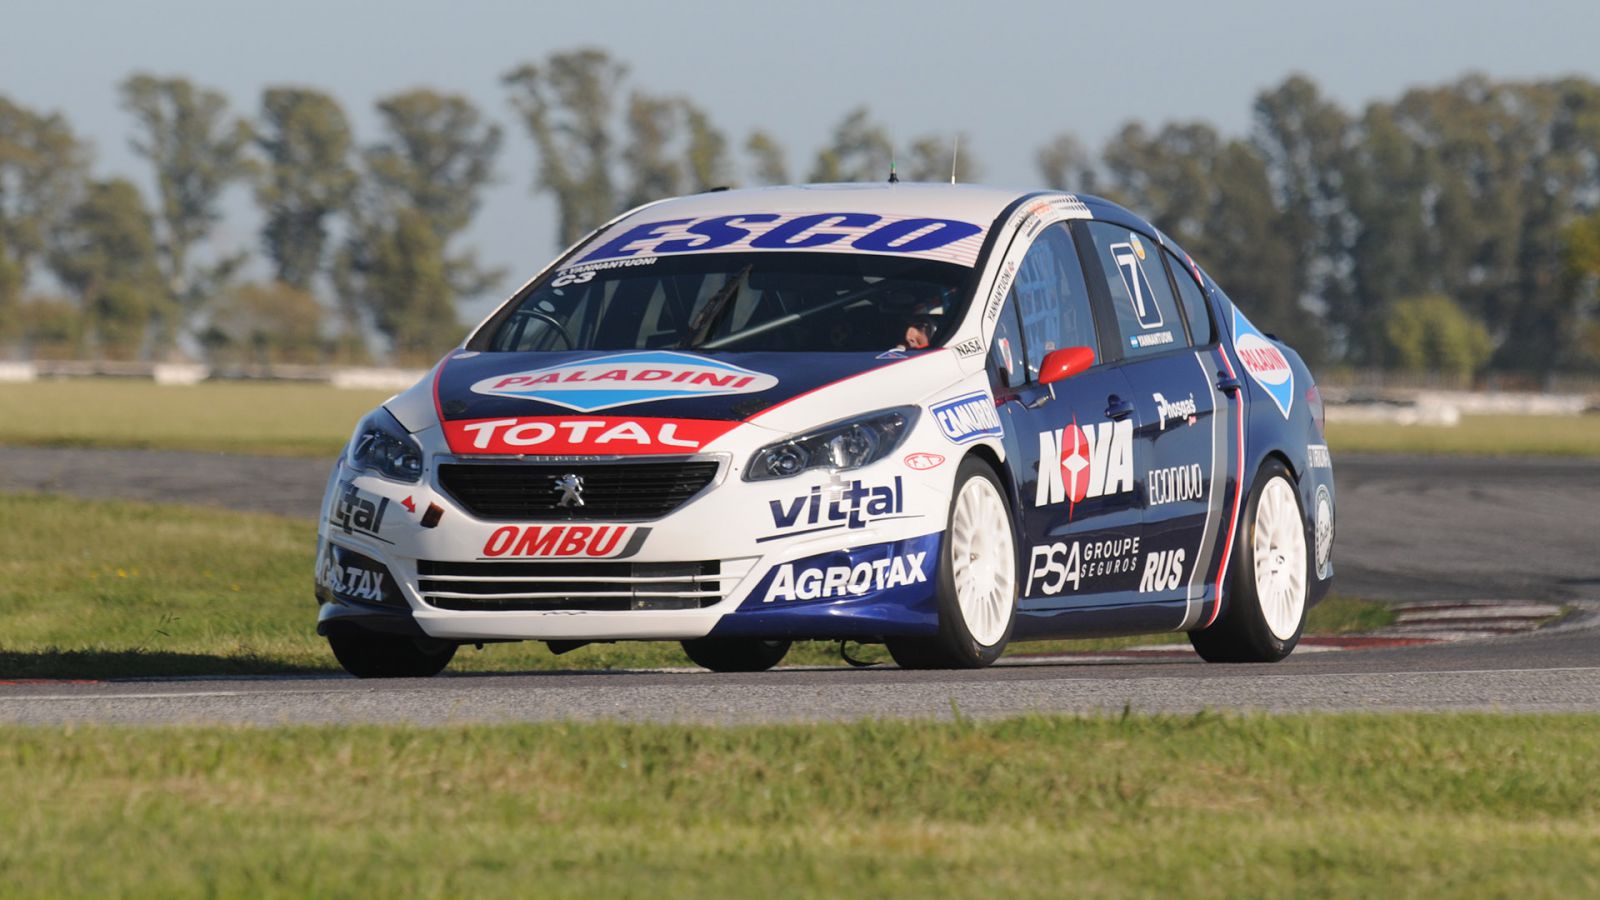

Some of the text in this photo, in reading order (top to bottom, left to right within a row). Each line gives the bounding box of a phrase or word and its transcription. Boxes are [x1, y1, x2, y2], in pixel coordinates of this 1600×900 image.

[574, 213, 983, 264] ESCO
[551, 271, 597, 288] C3
[569, 257, 658, 274] YANNANTUONI
[1117, 254, 1146, 317] 7
[956, 342, 983, 357] NASA
[1239, 347, 1288, 373] PALADINI
[492, 369, 757, 389] PALADINI
[1152, 392, 1197, 430] Phosgas
[463, 418, 701, 449] TOTAL
[1035, 418, 1134, 507] NOVA
[769, 475, 904, 529] vittal
[482, 526, 628, 556] OMBU
[1084, 536, 1140, 561] GROUPE
[763, 552, 927, 602] AGROTAX
[1024, 541, 1080, 597] PSA
[1080, 556, 1138, 578] SEGUROS
[1139, 547, 1186, 593] RUS
